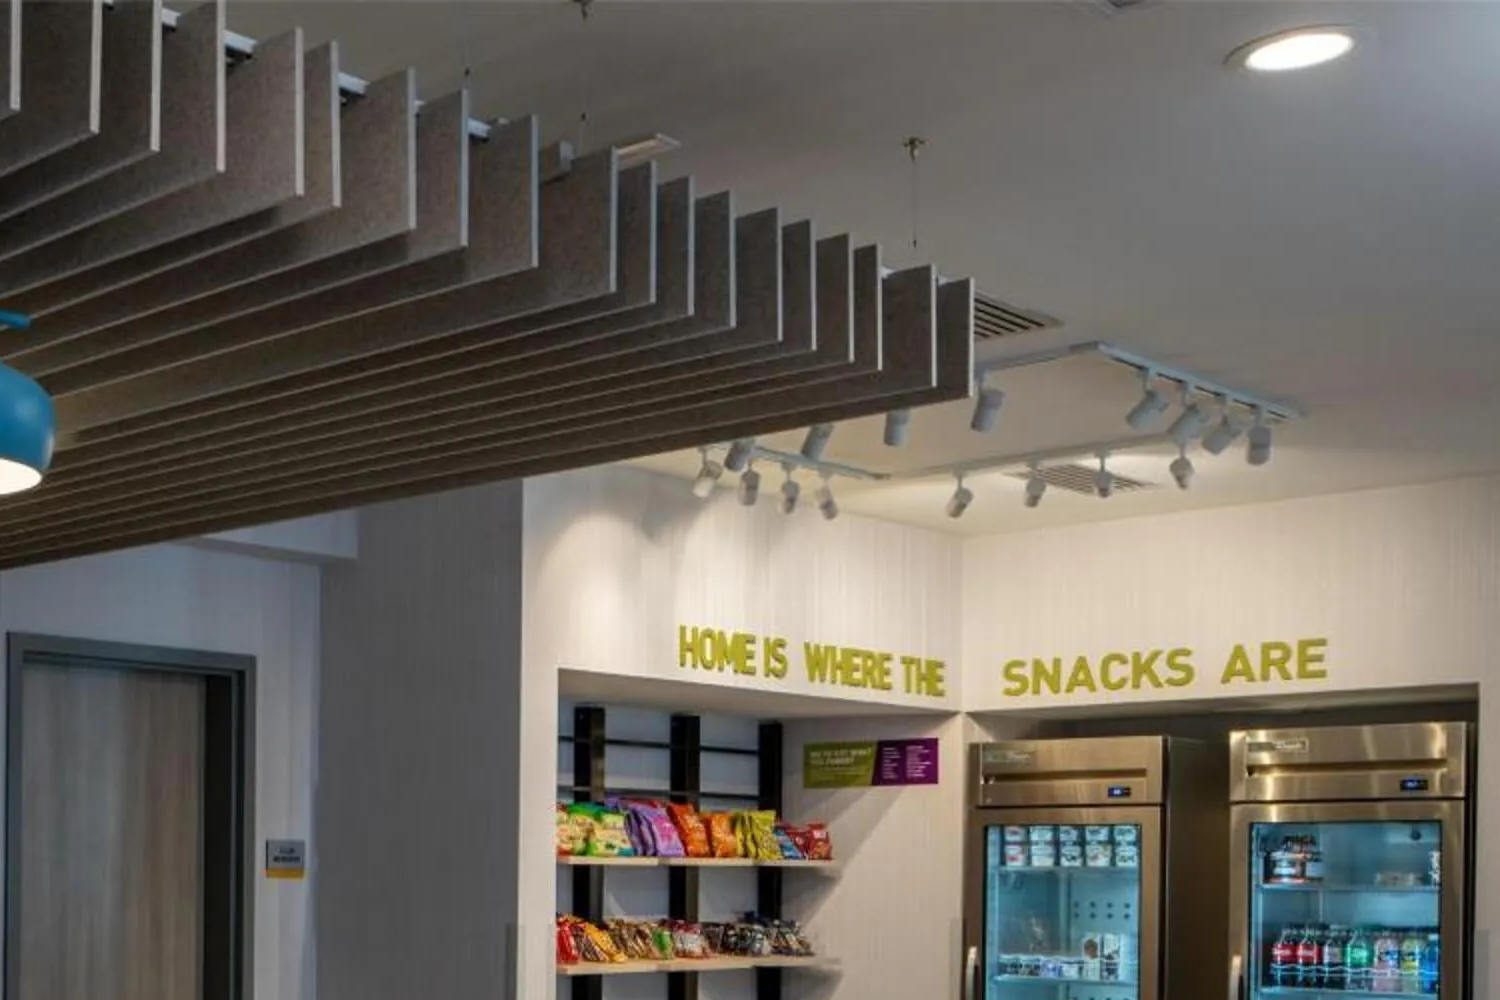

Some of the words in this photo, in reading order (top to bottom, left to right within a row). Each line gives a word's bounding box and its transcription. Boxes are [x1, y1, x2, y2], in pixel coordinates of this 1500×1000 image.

[679, 624, 757, 677] HOME
[763, 636, 788, 679] IS
[803, 641, 893, 691] WHERE
[900, 655, 946, 697] THE
[1002, 648, 1195, 697] SNACKS
[1220, 638, 1328, 685] ARE
